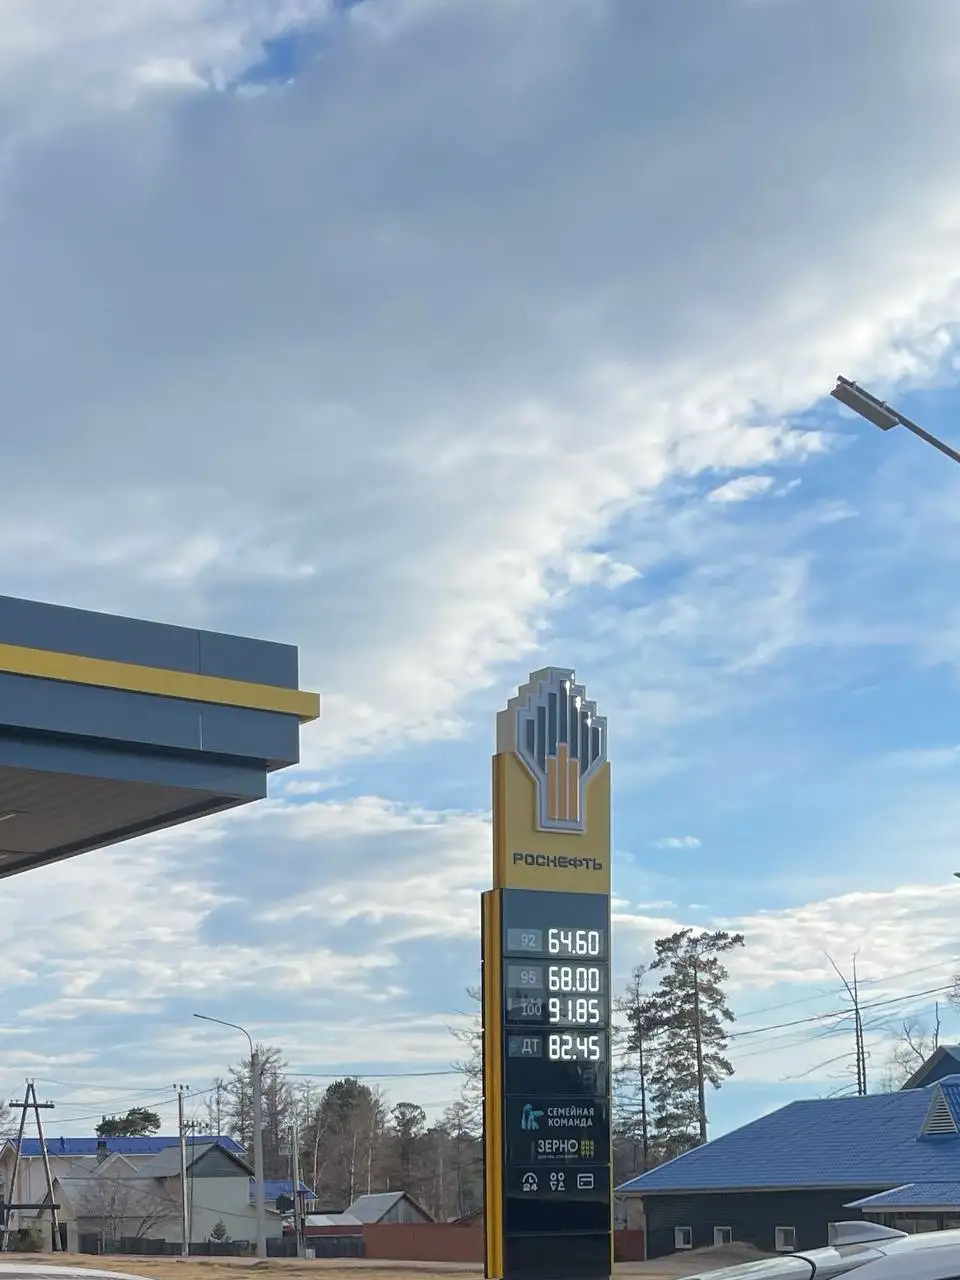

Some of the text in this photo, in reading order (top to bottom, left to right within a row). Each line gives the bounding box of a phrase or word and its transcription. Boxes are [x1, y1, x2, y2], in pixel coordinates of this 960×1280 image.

[513, 852, 603, 871] РОСНЕФТЬ
[521, 928, 599, 955] 92 64.60
[520, 966, 600, 992] 95 68.00
[521, 998, 600, 1023] 100 91.85
[521, 1034, 600, 1060] ДТ 82.45
[547, 1105, 595, 1117] СЕМЕЙНАЯ
[548, 1118, 594, 1128] КОМАНДА
[537, 1139, 579, 1153] ЗЕРНО
[522, 1183, 538, 1192] 24
